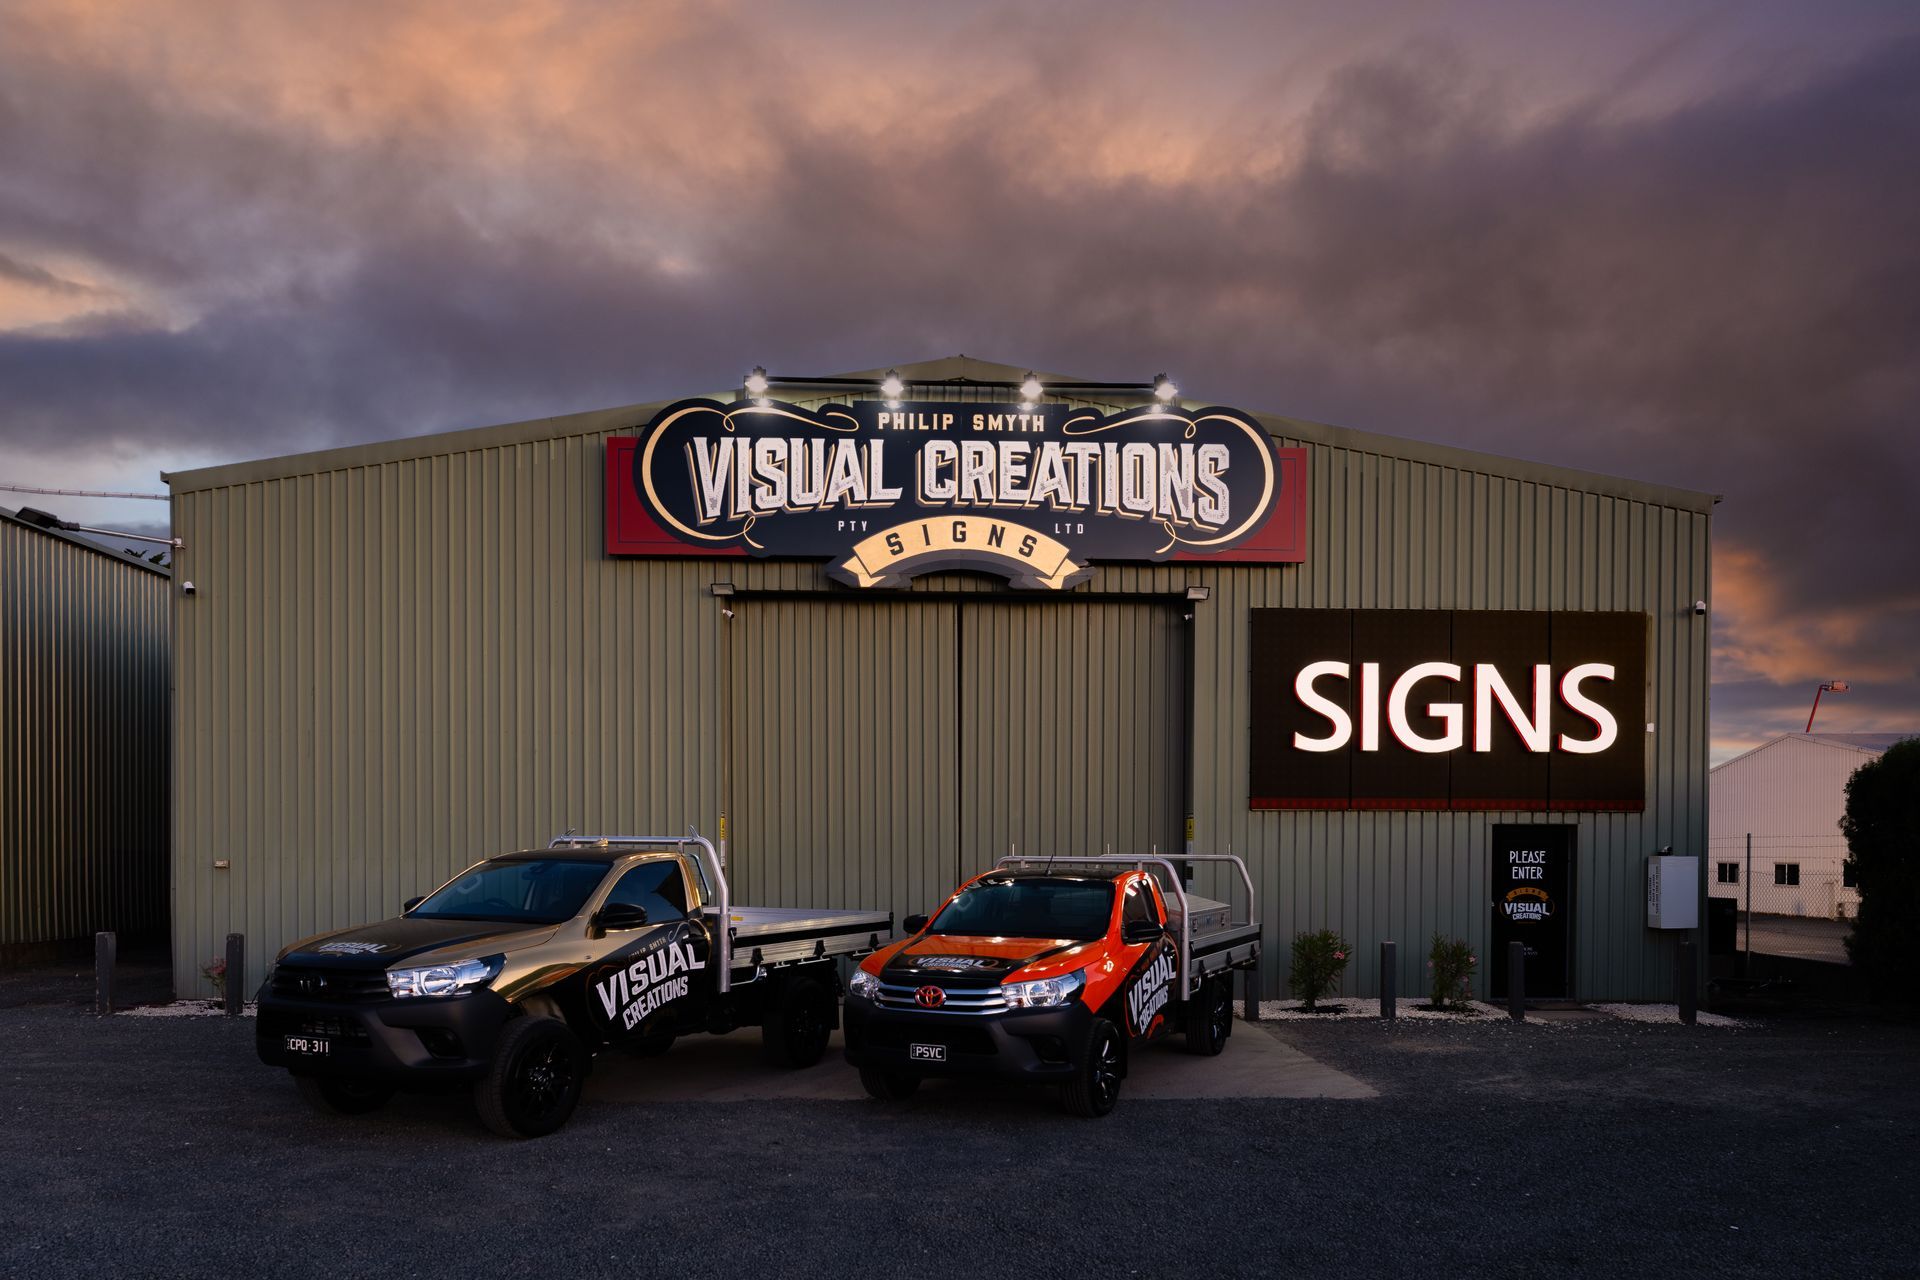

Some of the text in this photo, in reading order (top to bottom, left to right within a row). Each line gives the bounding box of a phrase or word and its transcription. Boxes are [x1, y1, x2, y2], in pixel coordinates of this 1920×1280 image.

[877, 412, 1045, 432] PHILIP SMYTH
[686, 436, 1230, 530] VISUAL CREATIONS
[838, 520, 1084, 534] PTY LTD
[885, 519, 1038, 558] SIGNS
[1293, 660, 1618, 754] SIGNS
[1509, 850, 1547, 864] PLEASE
[1511, 866, 1543, 880] ENTER
[1503, 902, 1550, 916] VISUAL
[1511, 911, 1543, 921] CREATIONS
[917, 957, 985, 968] VISUAL
[595, 941, 706, 1020] VISUAL
[1128, 952, 1176, 1026] VISUAL
[622, 975, 689, 1031] CREATIONS
[1138, 984, 1169, 1036] CREATIONS
[916, 1046, 942, 1059] PSVC
